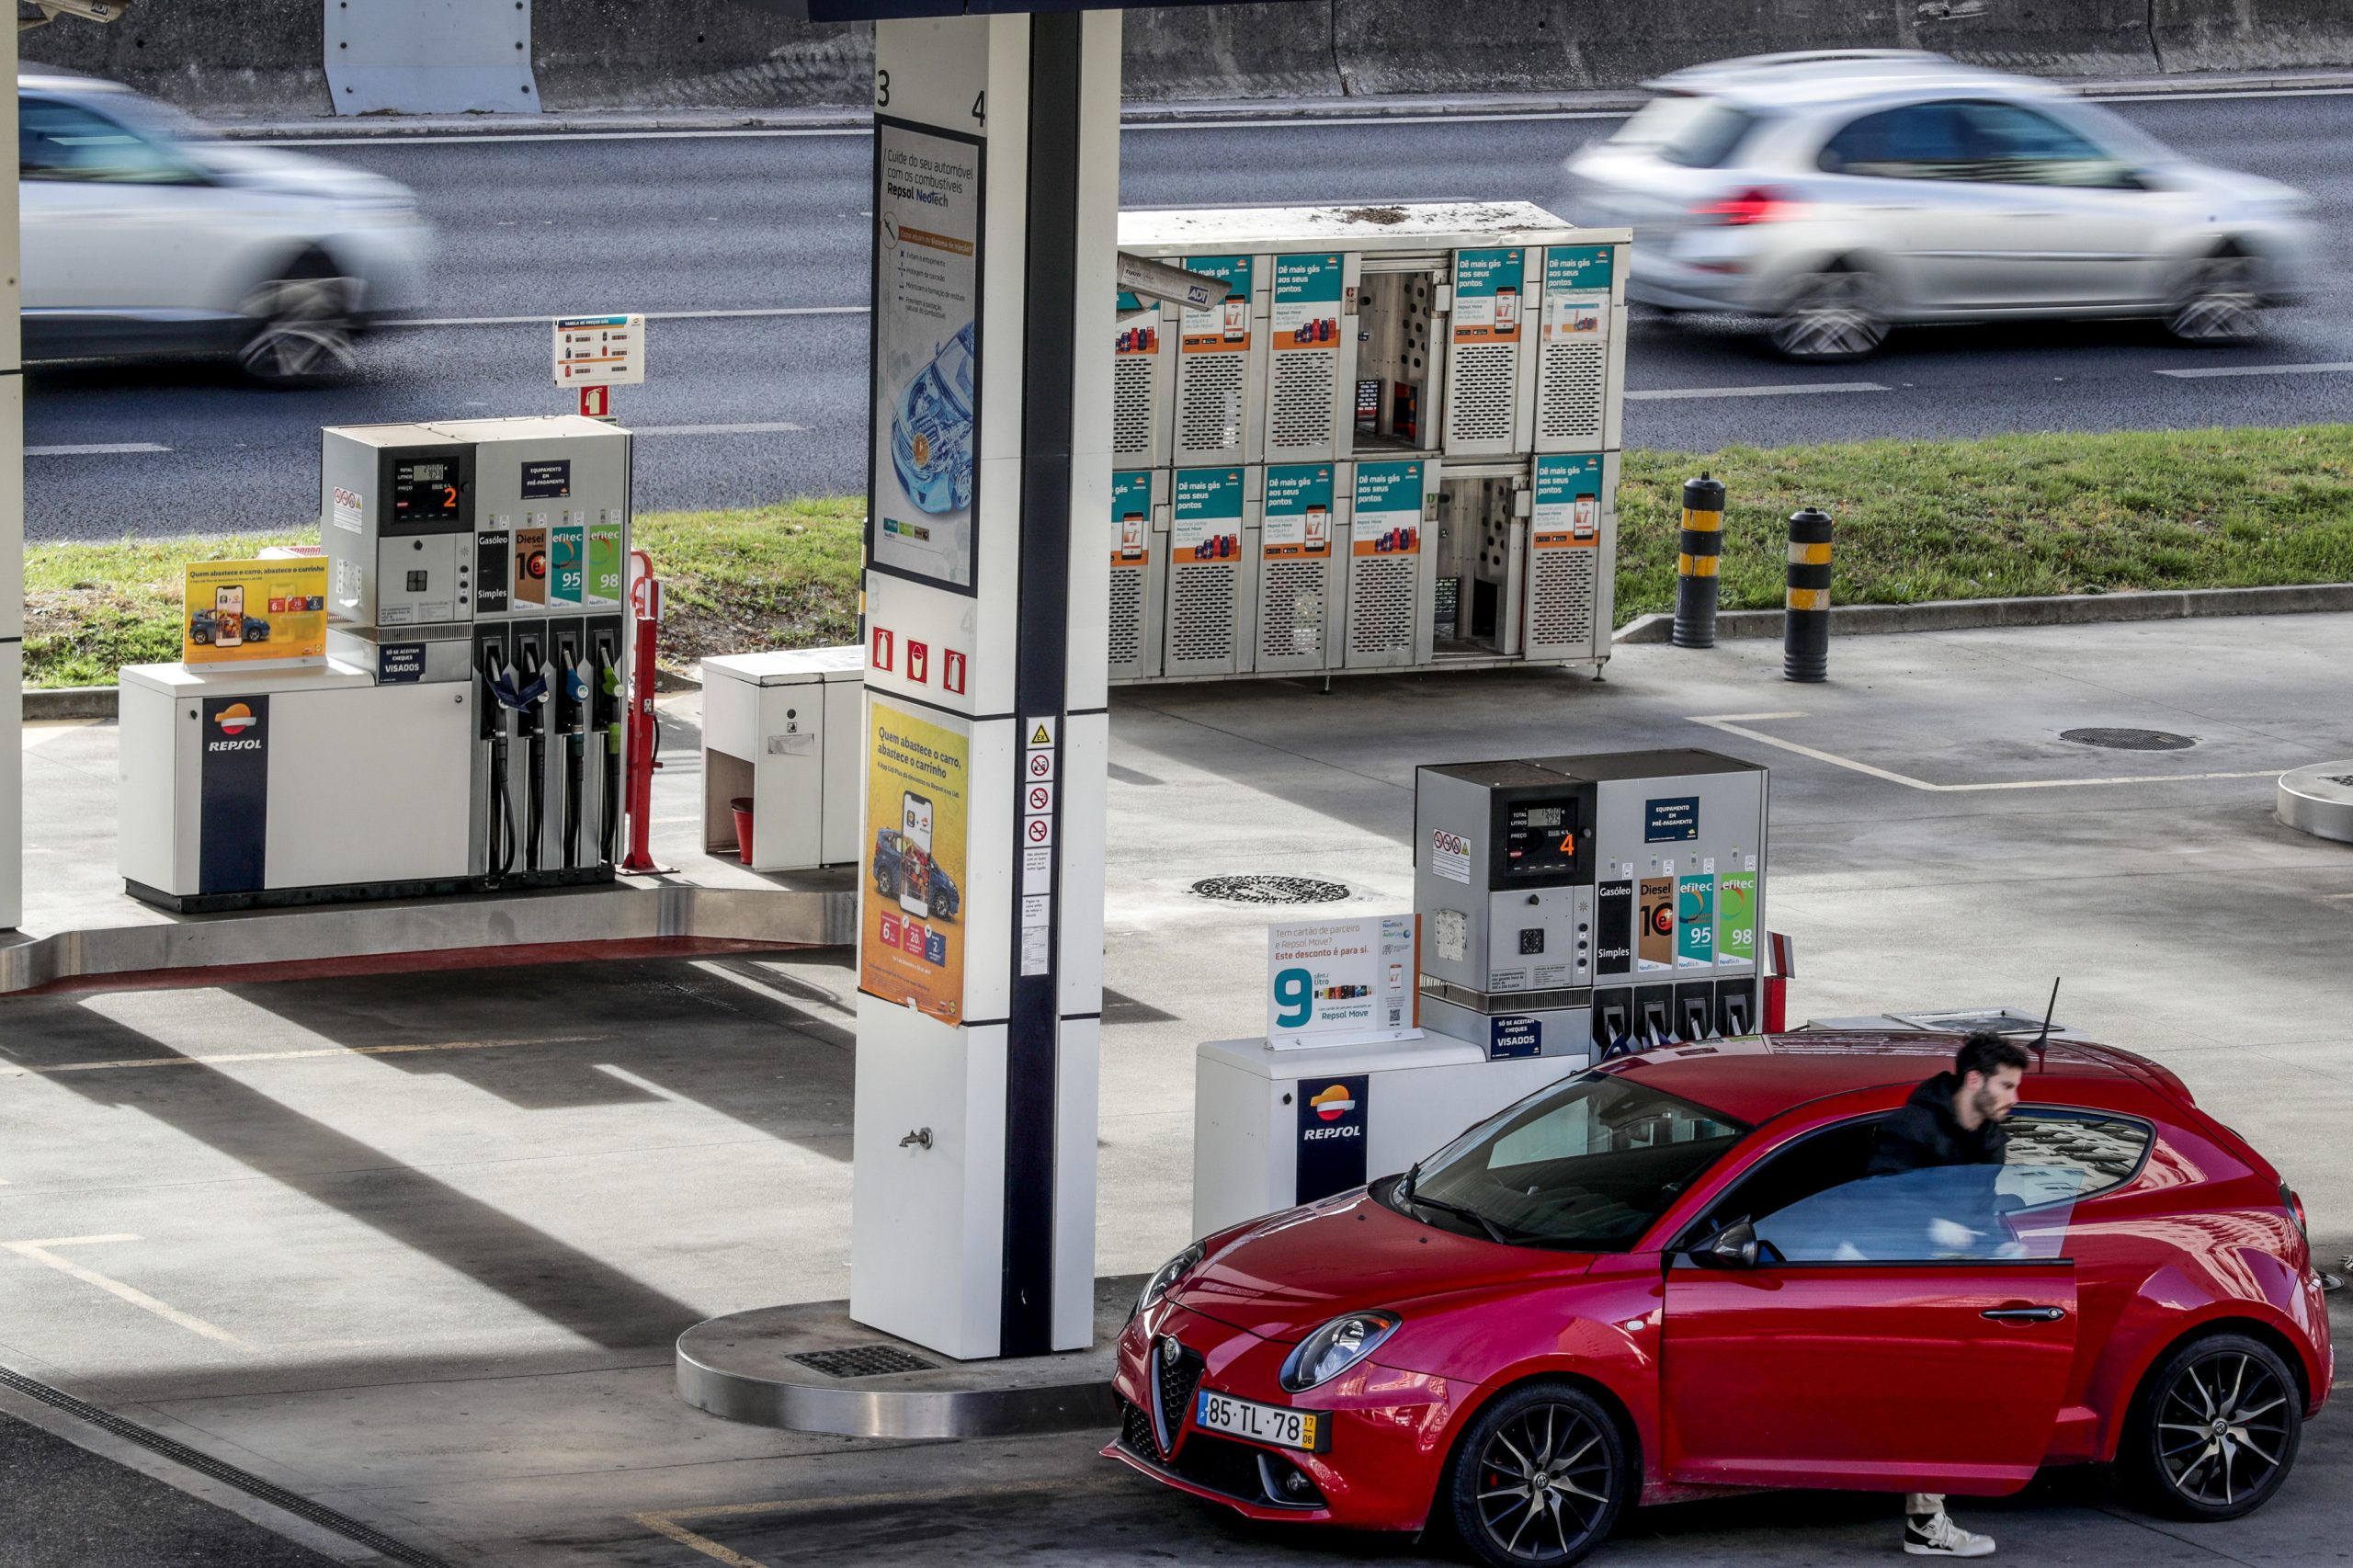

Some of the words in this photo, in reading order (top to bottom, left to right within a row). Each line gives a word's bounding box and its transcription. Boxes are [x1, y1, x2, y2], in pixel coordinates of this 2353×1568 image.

[878, 69, 890, 107] 3
[972, 90, 985, 127] 4
[888, 150, 907, 165] Cuide
[909, 154, 917, 167] do
[920, 158, 932, 170] seu
[935, 162, 973, 180] automóvel
[888, 167, 903, 180] com
[904, 172, 913, 182] os
[915, 174, 962, 194] combustíveis
[888, 182, 914, 199] Repsol
[1460, 260, 1470, 268] Dê
[1489, 259, 1501, 269] gás
[1549, 259, 1559, 267] Dê
[1560, 259, 1576, 267] mais
[1578, 258, 1590, 268] gás
[1217, 267, 1229, 278] gás
[1278, 265, 1288, 274] Dê
[1289, 265, 1306, 273] mais
[1307, 265, 1320, 274] gás
[1459, 280, 1483, 289] pontos
[1548, 279, 1572, 288] pontos
[1189, 289, 1207, 302] ADT
[1278, 286, 1302, 294] pontos
[1539, 467, 1549, 475] Dê
[1550, 467, 1566, 475] mais
[1567, 466, 1580, 476] gás
[1269, 478, 1279, 487] Dê
[1279, 478, 1296, 486] mais
[1298, 477, 1311, 487] gás
[1358, 475, 1368, 483] Dê
[1370, 475, 1386, 483] mais
[1388, 473, 1400, 483] gás
[1115, 485, 1128, 494] gás
[1178, 482, 1188, 490] Dê
[1189, 482, 1206, 490] mais
[1208, 481, 1221, 491] gás
[1538, 487, 1562, 496] pontos
[444, 487, 456, 506] 2
[1358, 495, 1382, 505] pontos
[1177, 502, 1202, 511] pontos
[1268, 498, 1292, 507] pontos
[479, 535, 507, 545] Gasóleo
[517, 534, 544, 544] Diesel
[552, 533, 582, 542] efitec
[591, 530, 619, 540] efitec
[563, 573, 580, 587] 95
[600, 574, 619, 588] 98
[478, 589, 506, 600] Simples
[272, 602, 278, 611] 6
[385, 664, 419, 673] VISADOS
[209, 739, 262, 752] REPSOL
[879, 726, 899, 744] Quem
[901, 736, 932, 757] abastece
[934, 751, 938, 759] o
[940, 754, 961, 770] carro,
[878, 743, 908, 764] abastece
[910, 758, 915, 767] o
[916, 762, 946, 778] carrinho
[1560, 834, 1574, 856] 4
[1641, 883, 1671, 895] Diesel
[1680, 882, 1712, 893] efitec
[1722, 879, 1754, 890] efitec
[1599, 886, 1631, 897] Gasóleo
[883, 923, 891, 939] 6
[1276, 929, 1291, 937] Tem
[1294, 926, 1317, 937] cartão
[1319, 926, 1328, 935] de
[1330, 925, 1360, 936] parceiro
[1690, 927, 1711, 944] 95
[911, 931, 918, 943] 20
[1732, 929, 1753, 945] 98
[933, 941, 938, 952] 2
[1282, 940, 1306, 950] Repsol
[1309, 937, 1333, 946] Move?
[1276, 952, 1293, 960] Este
[1295, 949, 1331, 959] desconto
[1334, 948, 1338, 956] é
[1341, 948, 1358, 957] para
[1360, 946, 1369, 954] si.
[1597, 947, 1630, 960] Simples
[1274, 968, 1313, 1028] 9
[1322, 1011, 1347, 1021] Repsol
[1497, 1035, 1535, 1047] VISADOS
[1304, 1126, 1360, 1140] REPSOL
[1304, 1416, 1313, 1426] 17
[1302, 1435, 1313, 1444] 08
